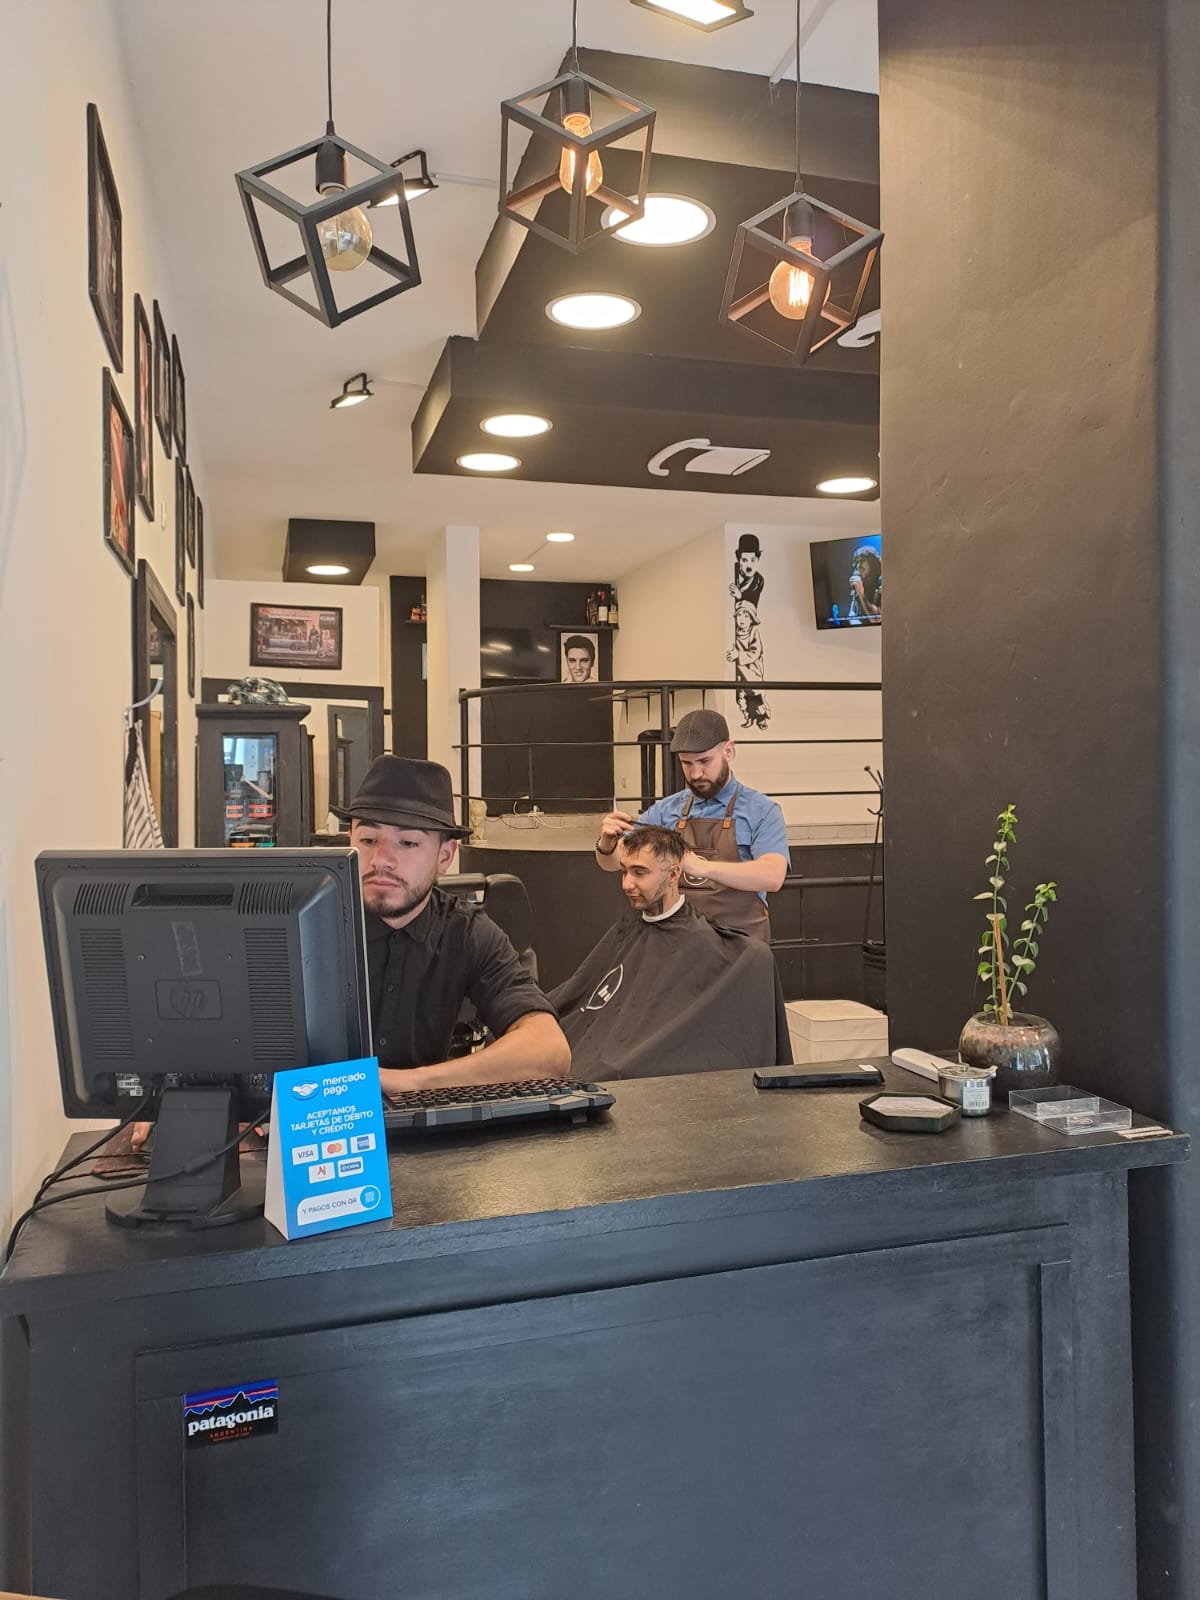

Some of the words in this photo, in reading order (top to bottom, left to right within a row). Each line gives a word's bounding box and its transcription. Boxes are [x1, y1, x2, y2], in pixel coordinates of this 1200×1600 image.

[322, 1072, 366, 1086] mercado
[323, 1084, 348, 1097] pago
[306, 1105, 356, 1120] ACEPTAMOS
[290, 1117, 330, 1131] TARJETAS
[331, 1115, 343, 1125] DE
[297, 1150, 314, 1159] VISA
[308, 1203, 331, 1213] PAGOS
[331, 1199, 347, 1208] CON
[187, 1405, 274, 1436] patagonia
